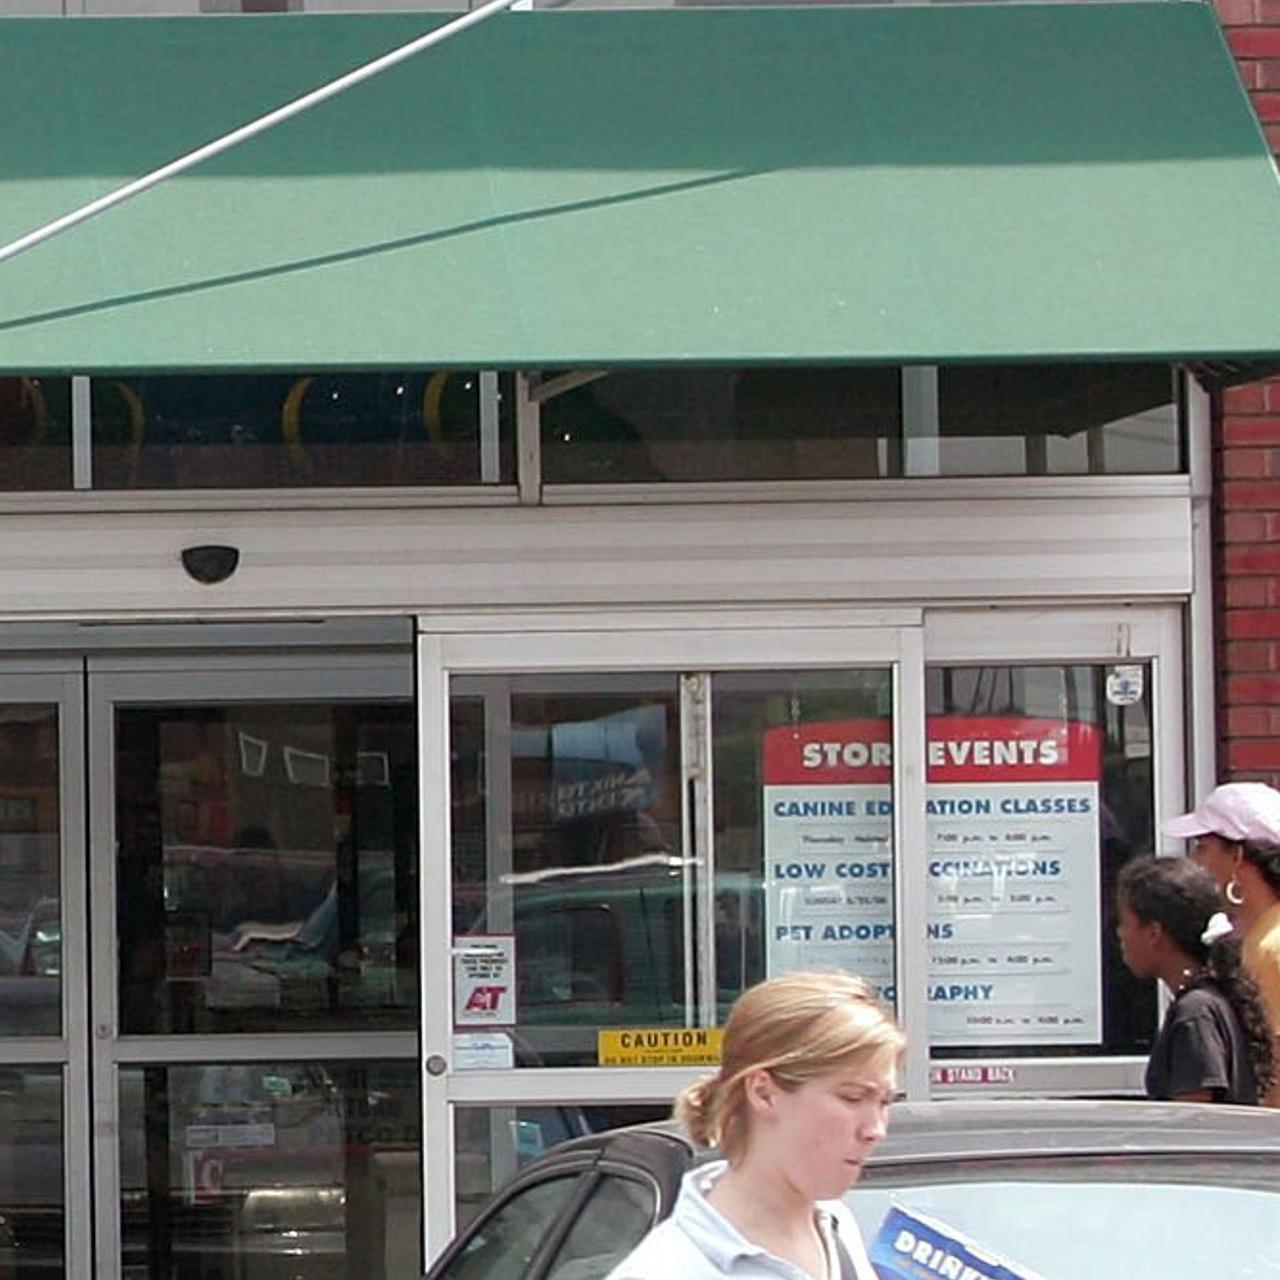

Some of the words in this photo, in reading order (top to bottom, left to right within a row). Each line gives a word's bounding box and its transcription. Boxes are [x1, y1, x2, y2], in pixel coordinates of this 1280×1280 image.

[802, 742, 894, 768] STOR
[928, 740, 1058, 766] EVENTS
[774, 800, 856, 817] CANINE
[866, 799, 991, 816] EDATION
[1001, 798, 1091, 814] CLASSES
[775, 863, 827, 879] LOW
[836, 862, 890, 878] COST
[776, 925, 812, 941] PET
[822, 923, 954, 940] ADOPTNS
[620, 1031, 708, 1049] CAUTION
